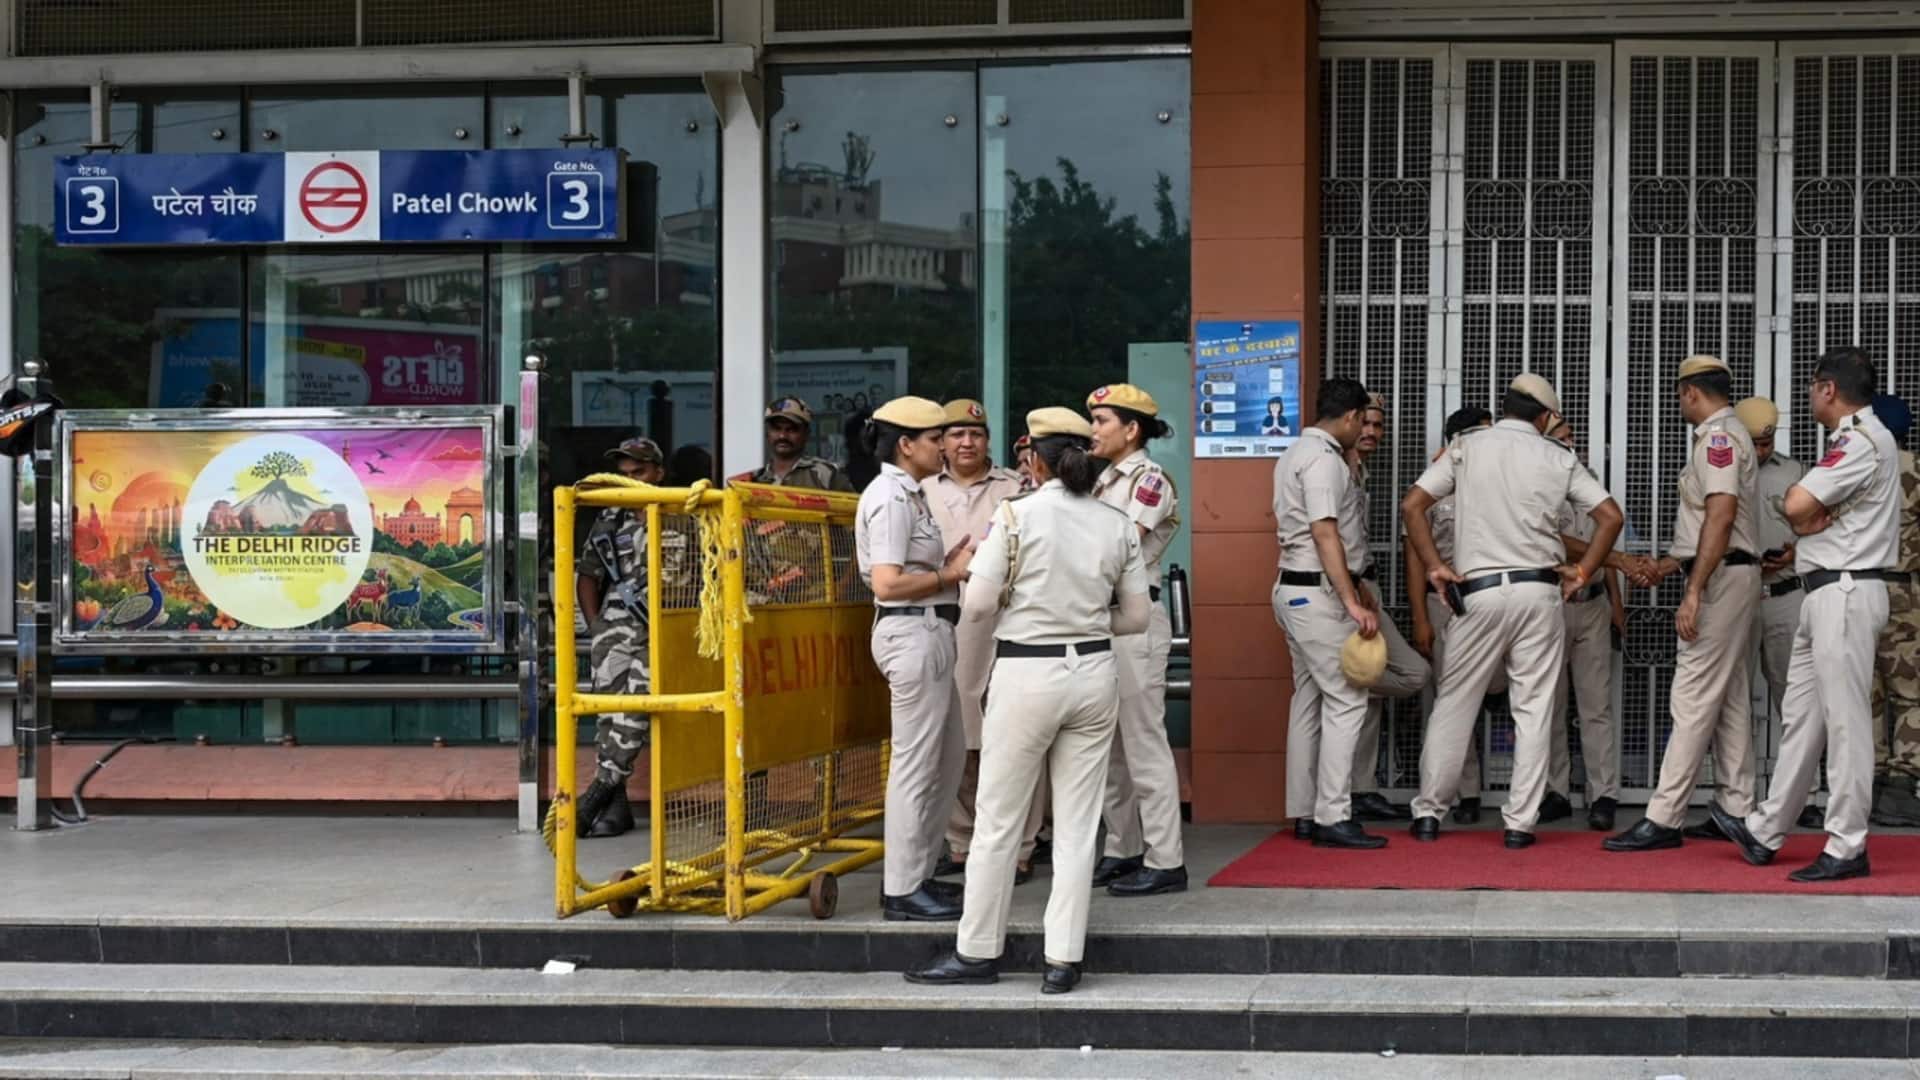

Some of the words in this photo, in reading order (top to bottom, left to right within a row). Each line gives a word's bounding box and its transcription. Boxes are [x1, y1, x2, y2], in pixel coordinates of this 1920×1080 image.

[554, 161, 577, 170] Gate
[580, 161, 596, 170] No.
[80, 185, 106, 225] 3
[152, 187, 204, 216] पटेल
[210, 186, 258, 216] चौक
[392, 193, 451, 213] Patel
[458, 192, 538, 213] Chowk
[562, 180, 590, 220] 3
[192, 537, 230, 552] THE
[238, 537, 294, 552] DELHI
[302, 537, 361, 553] RIDGE
[206, 555, 300, 565] INTERPRETATION
[303, 555, 347, 565] CENTRE
